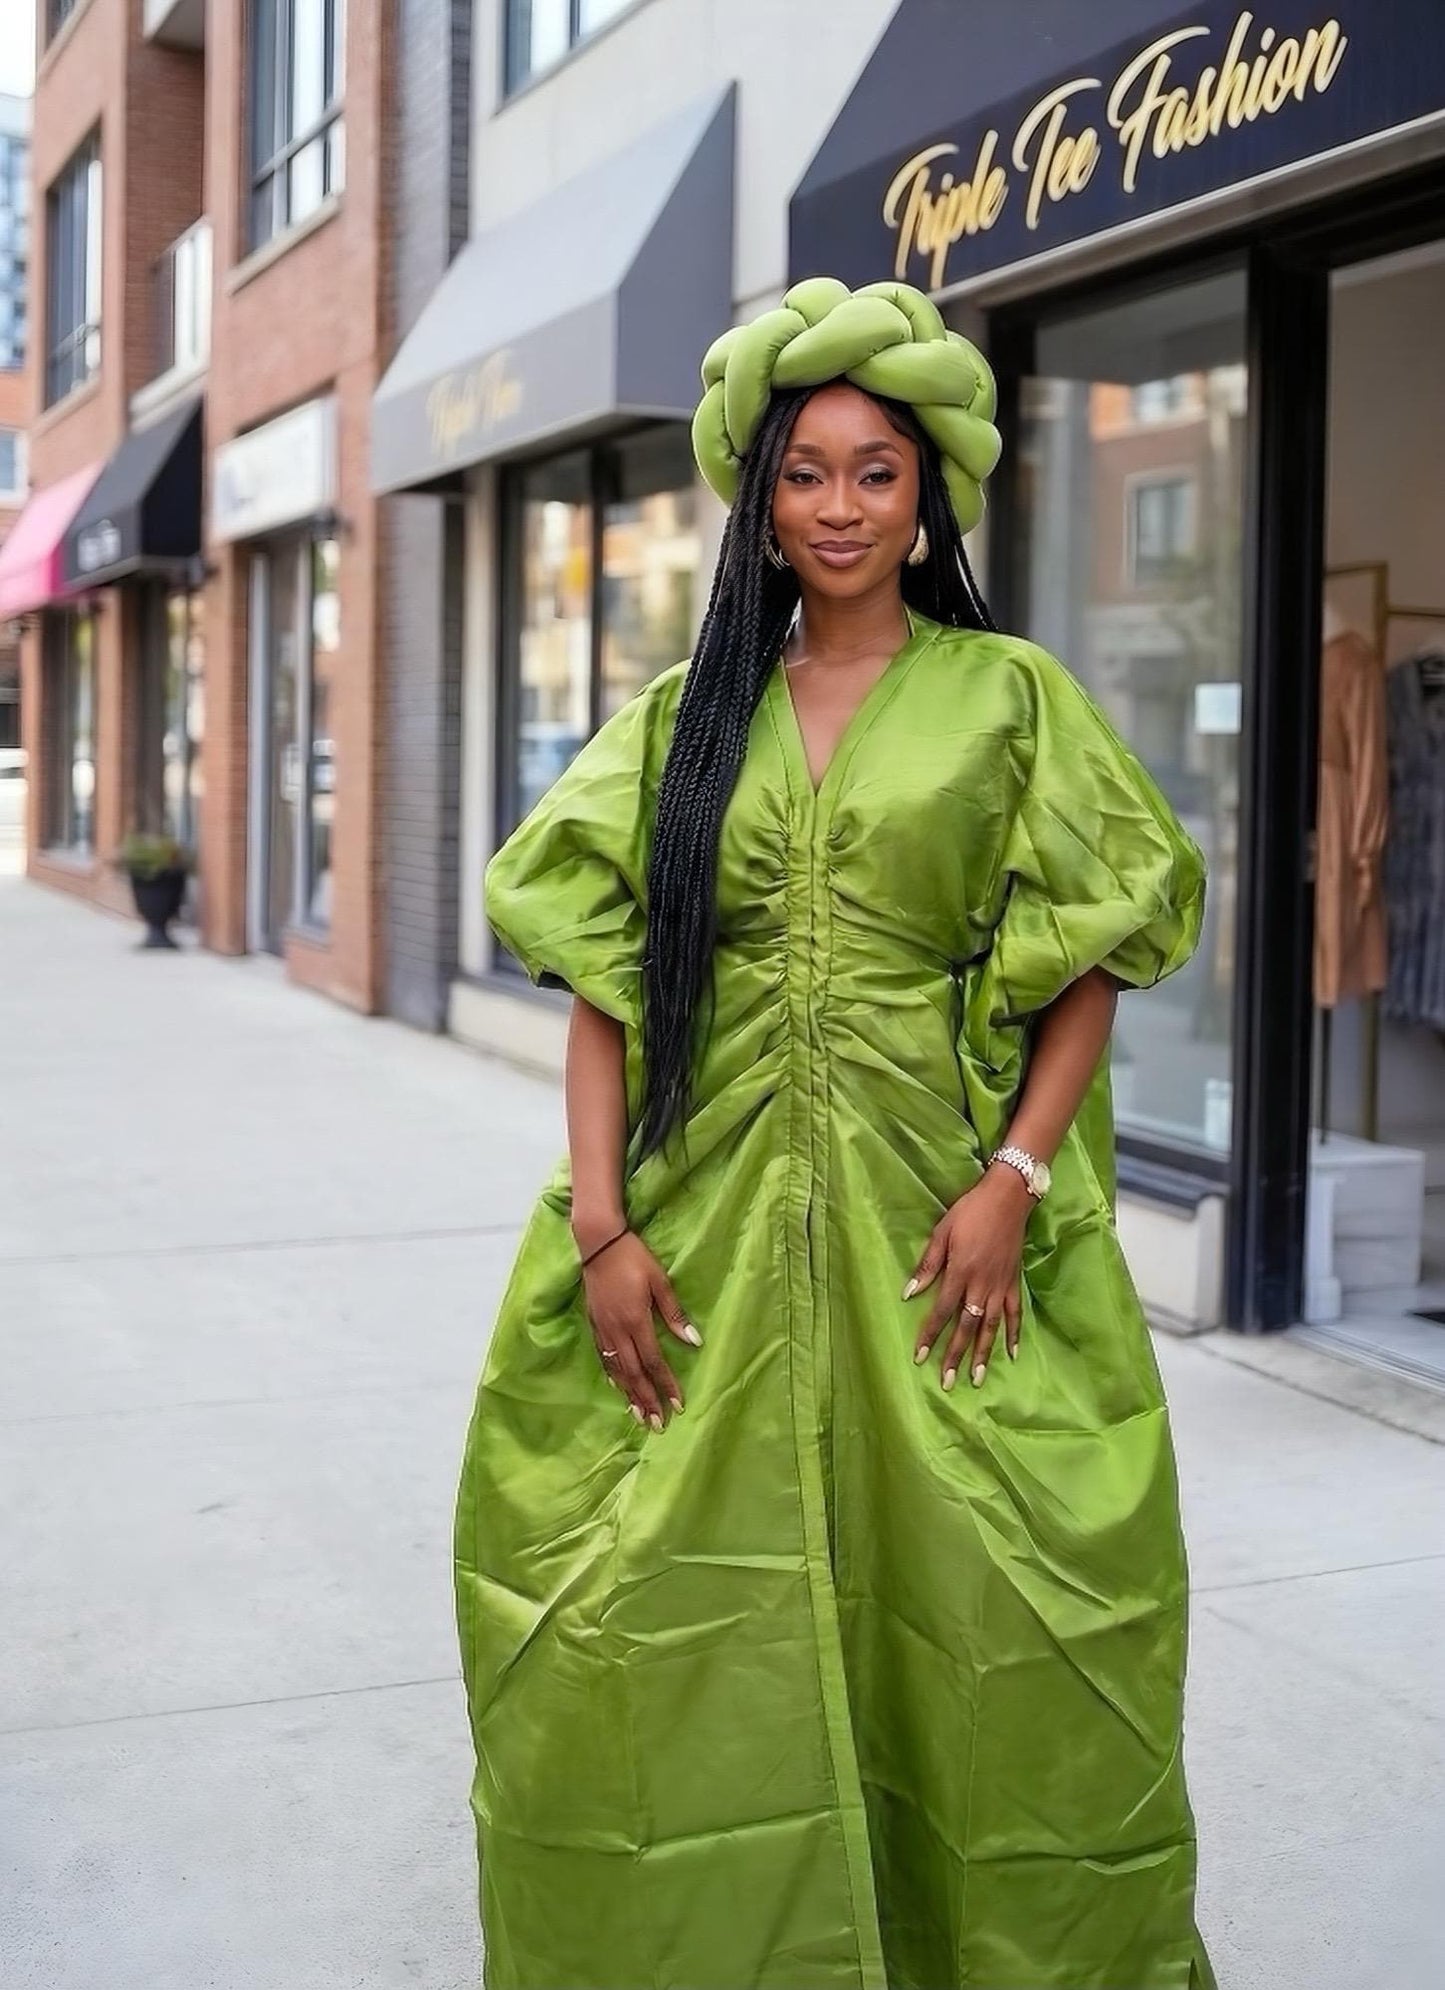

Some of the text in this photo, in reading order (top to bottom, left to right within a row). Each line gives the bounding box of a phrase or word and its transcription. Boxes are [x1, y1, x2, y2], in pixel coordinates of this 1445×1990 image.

[883, 11, 1348, 290] Triple Tee Fashion
